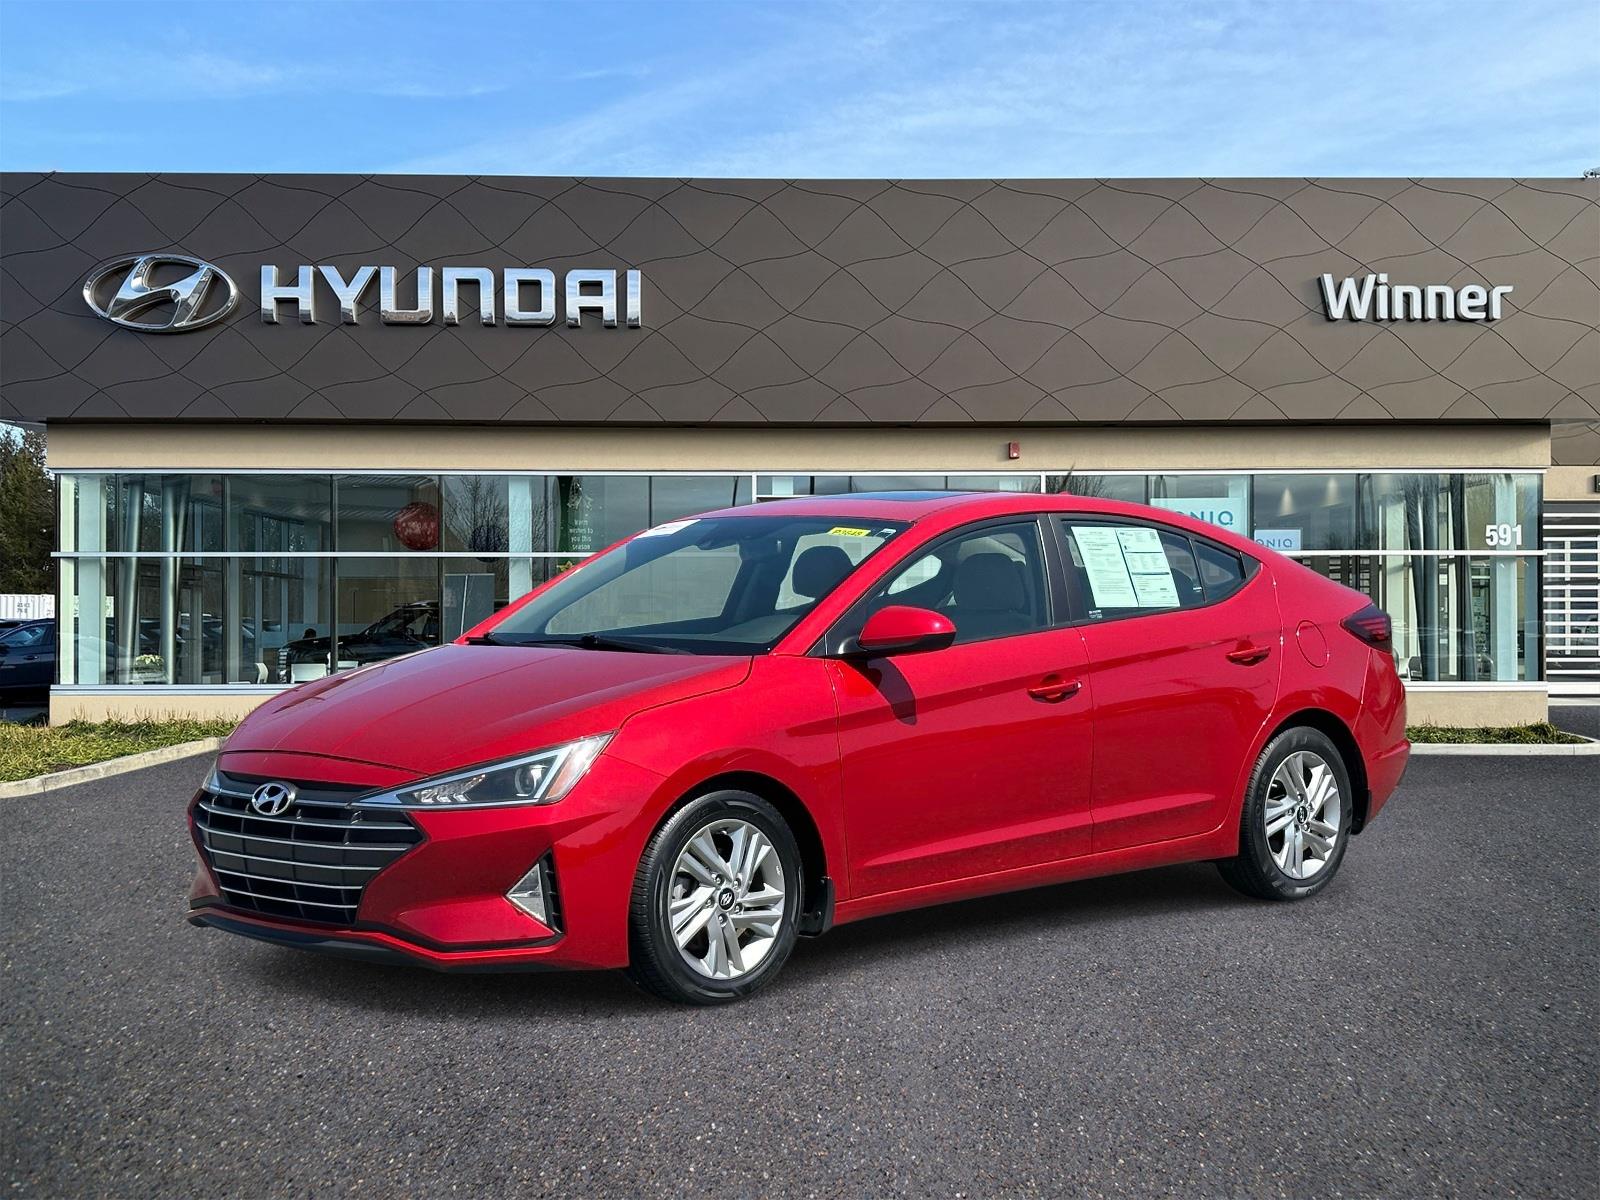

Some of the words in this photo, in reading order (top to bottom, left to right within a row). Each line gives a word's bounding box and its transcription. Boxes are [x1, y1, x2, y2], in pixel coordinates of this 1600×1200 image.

[260, 264, 641, 328] HYUNDAI
[1320, 273, 1514, 321] Winner
[1485, 523, 1522, 546] 591
